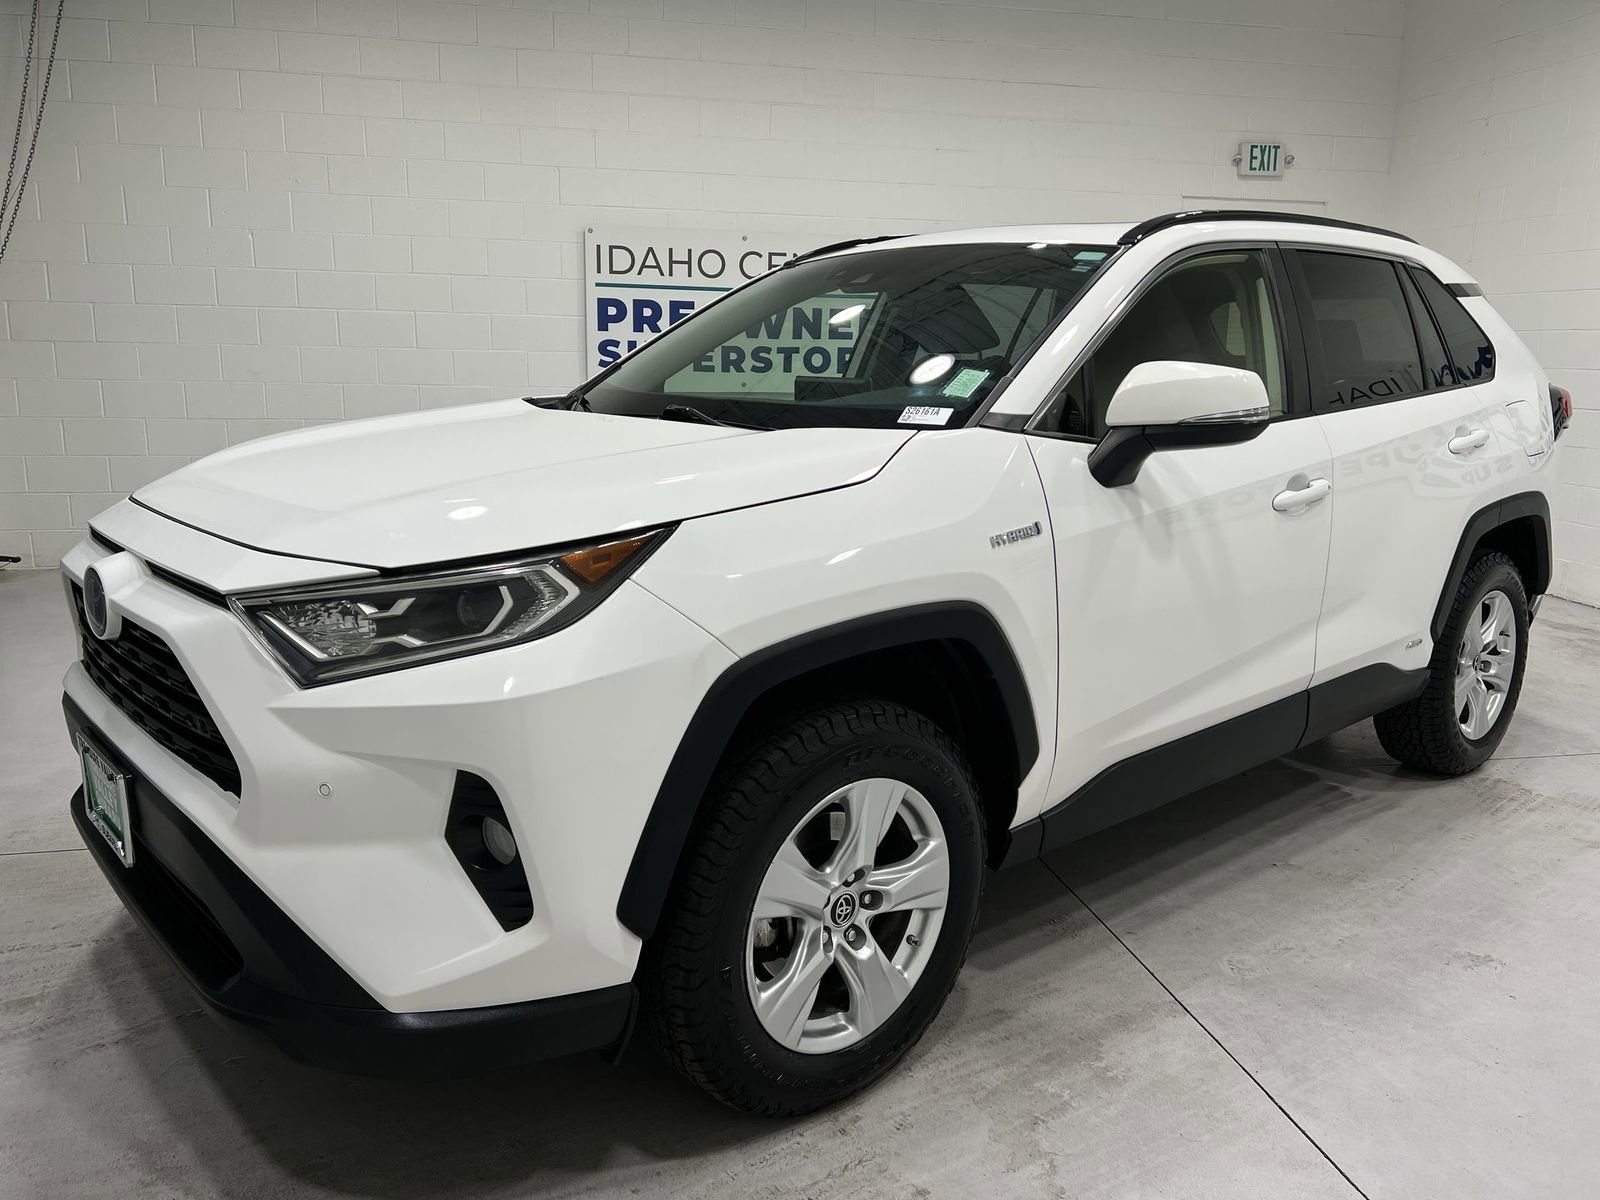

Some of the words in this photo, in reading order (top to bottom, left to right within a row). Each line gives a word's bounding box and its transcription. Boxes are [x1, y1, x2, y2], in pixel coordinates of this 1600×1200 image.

[1248, 144, 1281, 172] EXIT
[596, 244, 726, 279] IDAHO
[738, 250, 801, 279] CE
[905, 406, 941, 416] S26161A
[989, 523, 1038, 549] HYBRID
